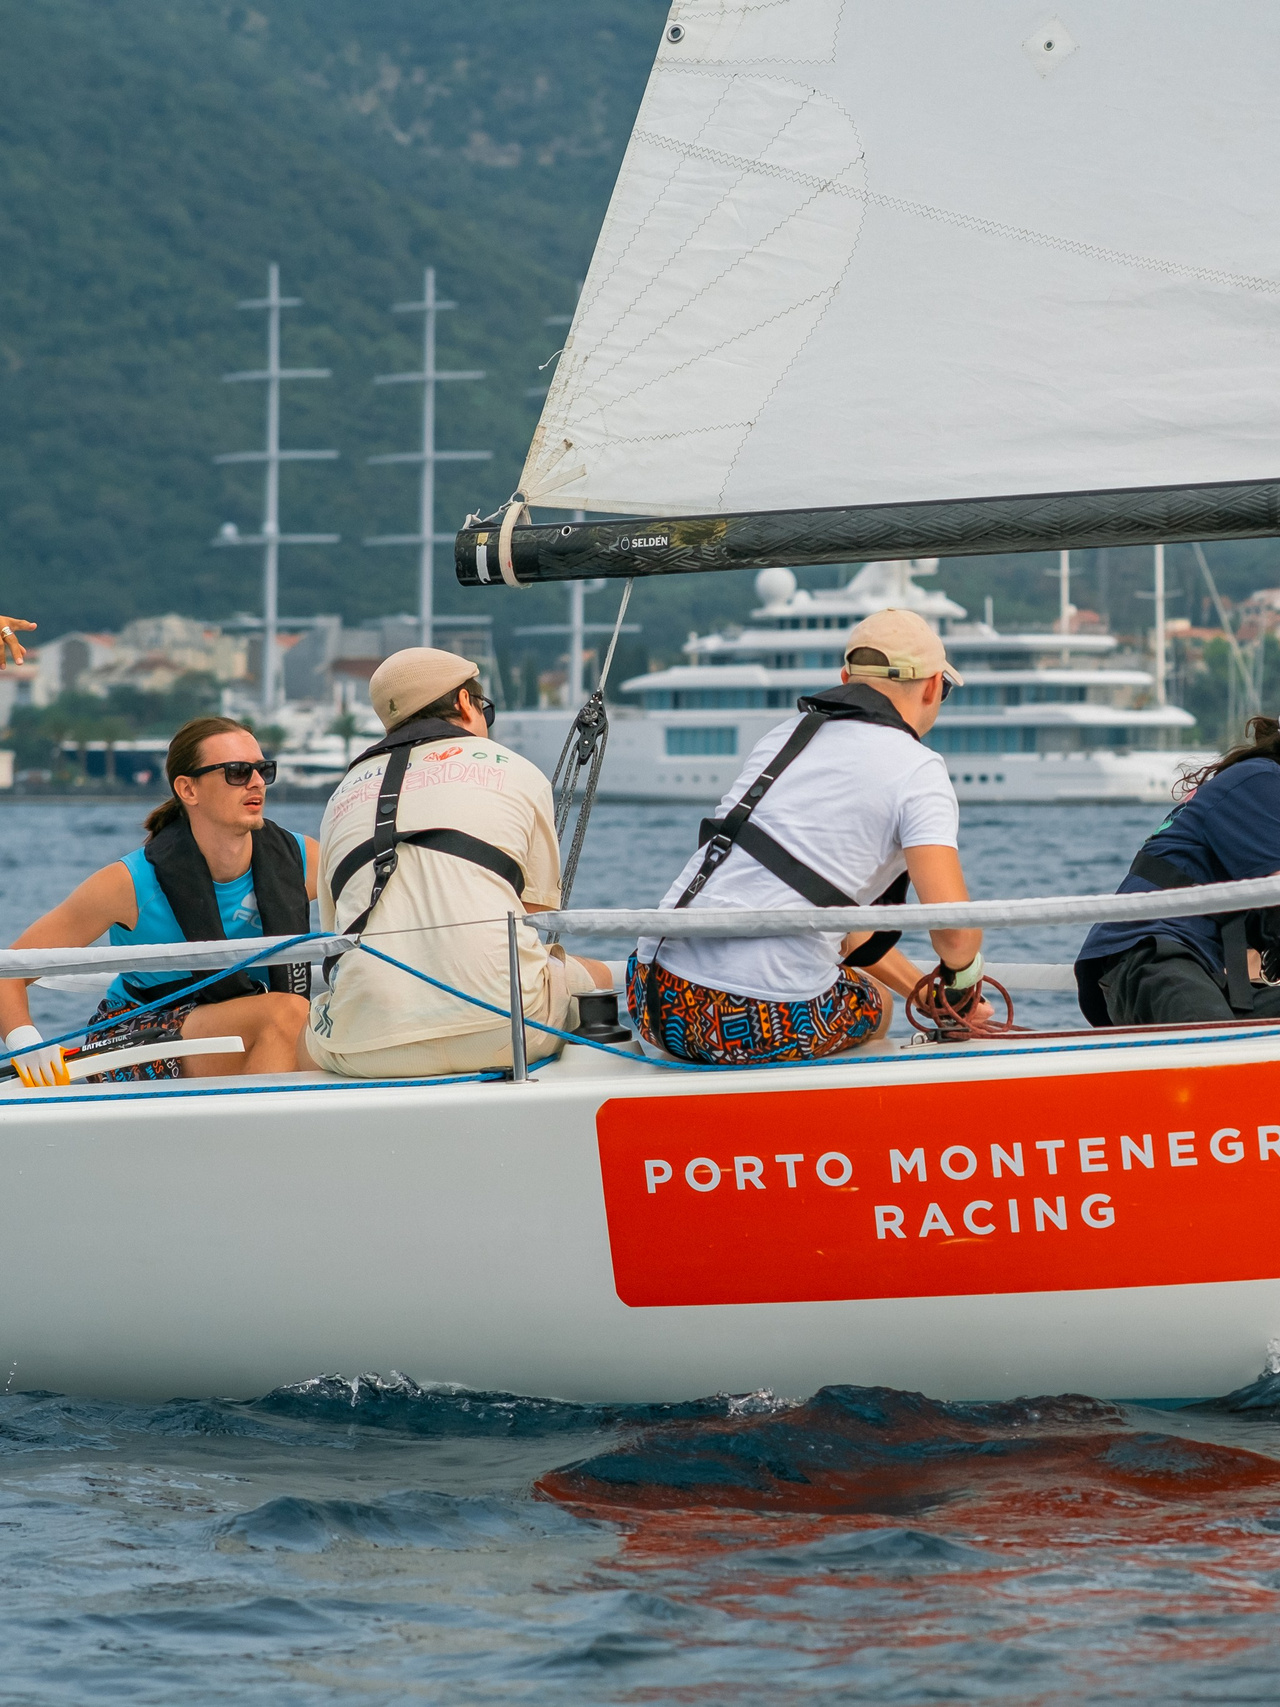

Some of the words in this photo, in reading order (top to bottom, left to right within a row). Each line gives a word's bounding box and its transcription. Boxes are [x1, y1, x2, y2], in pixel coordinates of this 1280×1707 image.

[631, 534, 668, 548] SELDÉN
[472, 751, 509, 764] OF
[331, 762, 505, 822] AMSERDAM
[644, 1151, 854, 1194] PORTO
[874, 1193, 1117, 1240] RACING
